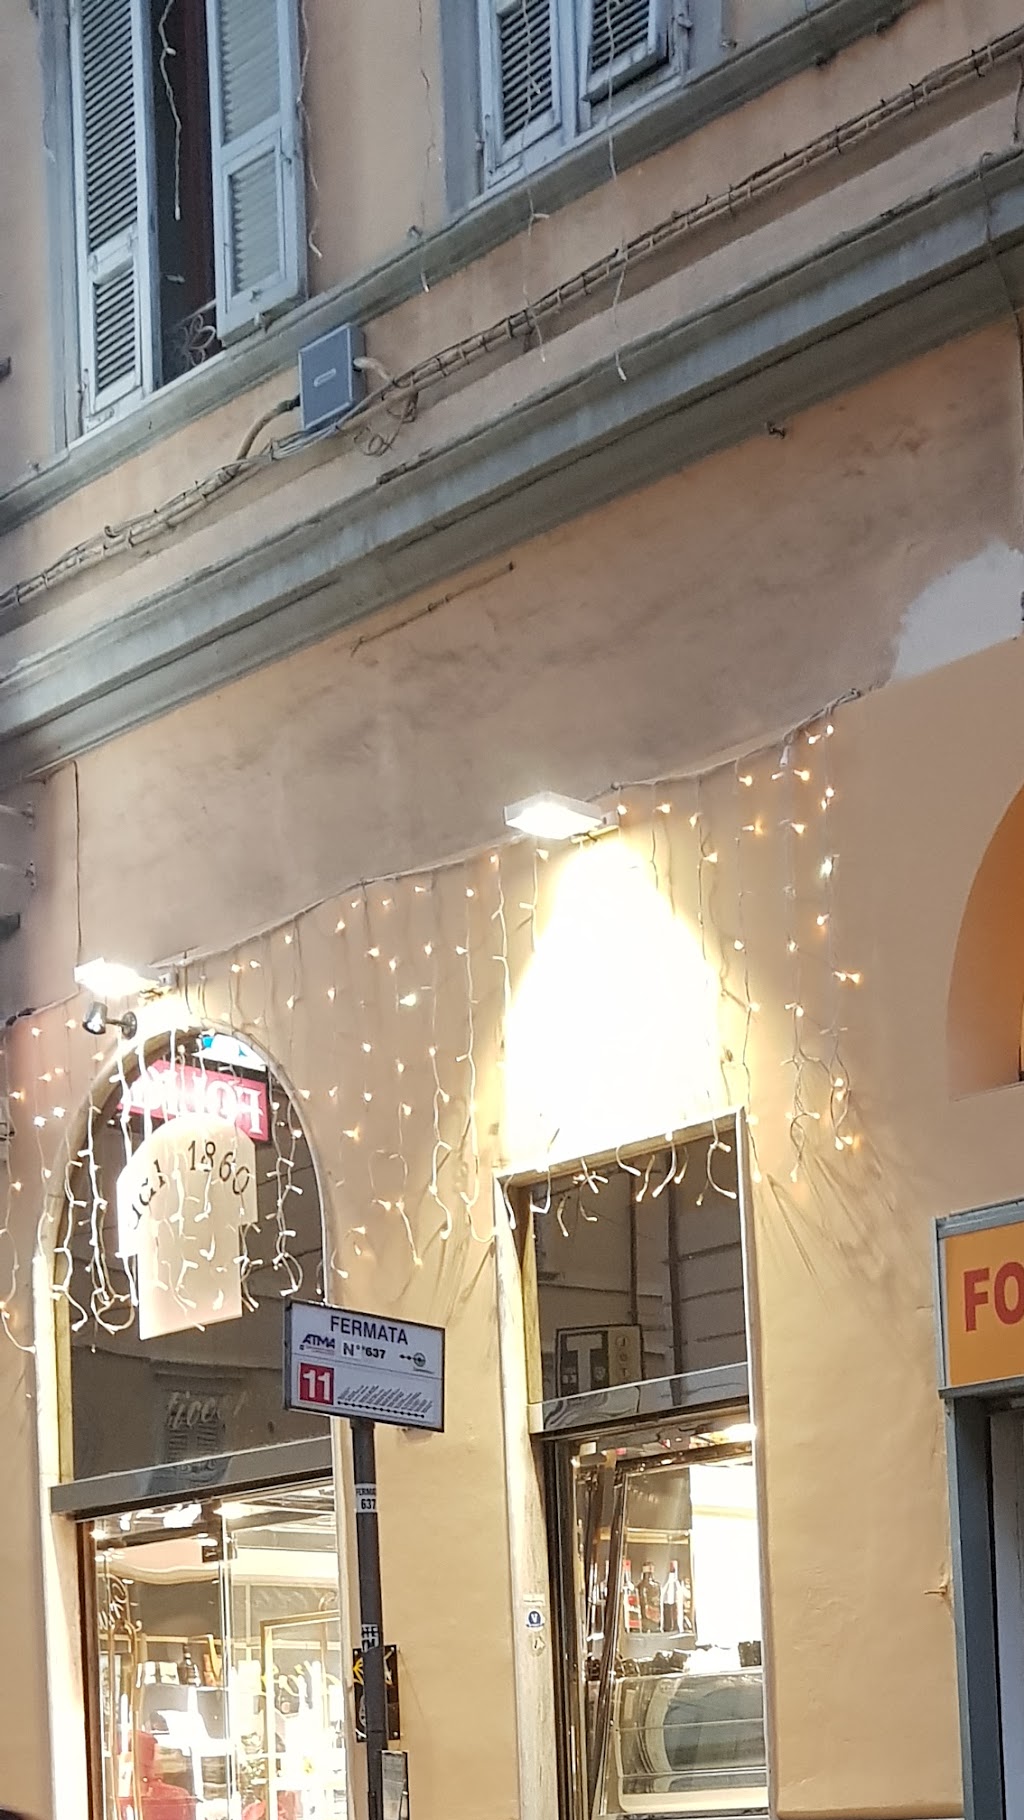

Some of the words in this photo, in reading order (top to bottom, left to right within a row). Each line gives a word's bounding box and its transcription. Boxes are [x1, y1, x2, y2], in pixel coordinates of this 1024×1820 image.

[187, 1140, 250, 1194] 1860
[330, 1315, 408, 1345] FERMATA
[365, 1346, 386, 1359] 637
[302, 1369, 331, 1401] 11
[361, 1499, 376, 1509] 637
